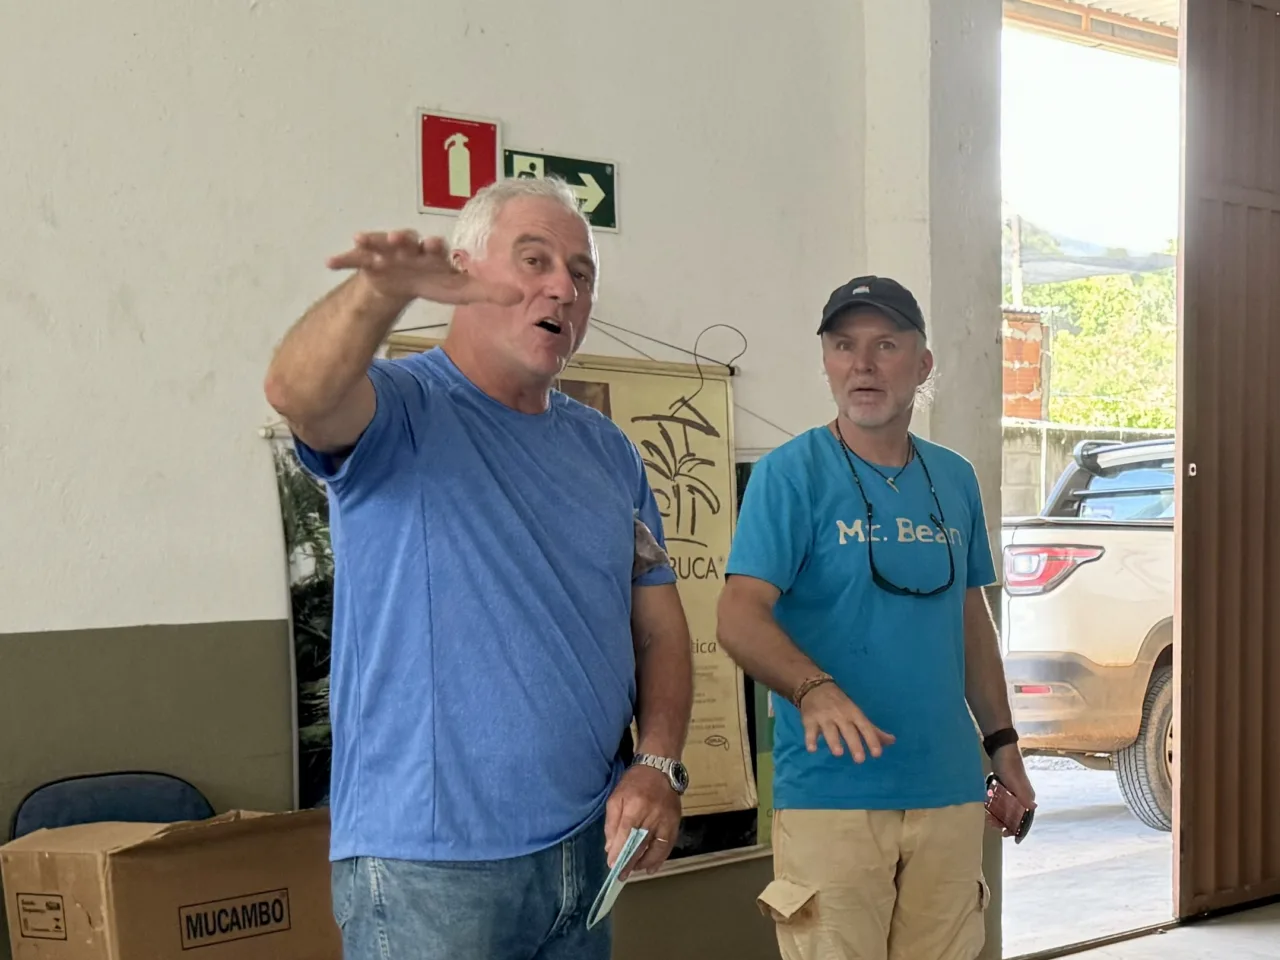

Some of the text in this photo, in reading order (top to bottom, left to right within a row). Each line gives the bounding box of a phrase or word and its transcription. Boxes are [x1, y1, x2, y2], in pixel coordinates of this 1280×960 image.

[836, 517, 962, 546] Mr. Bean
[185, 898, 284, 940] MUCAMBO
